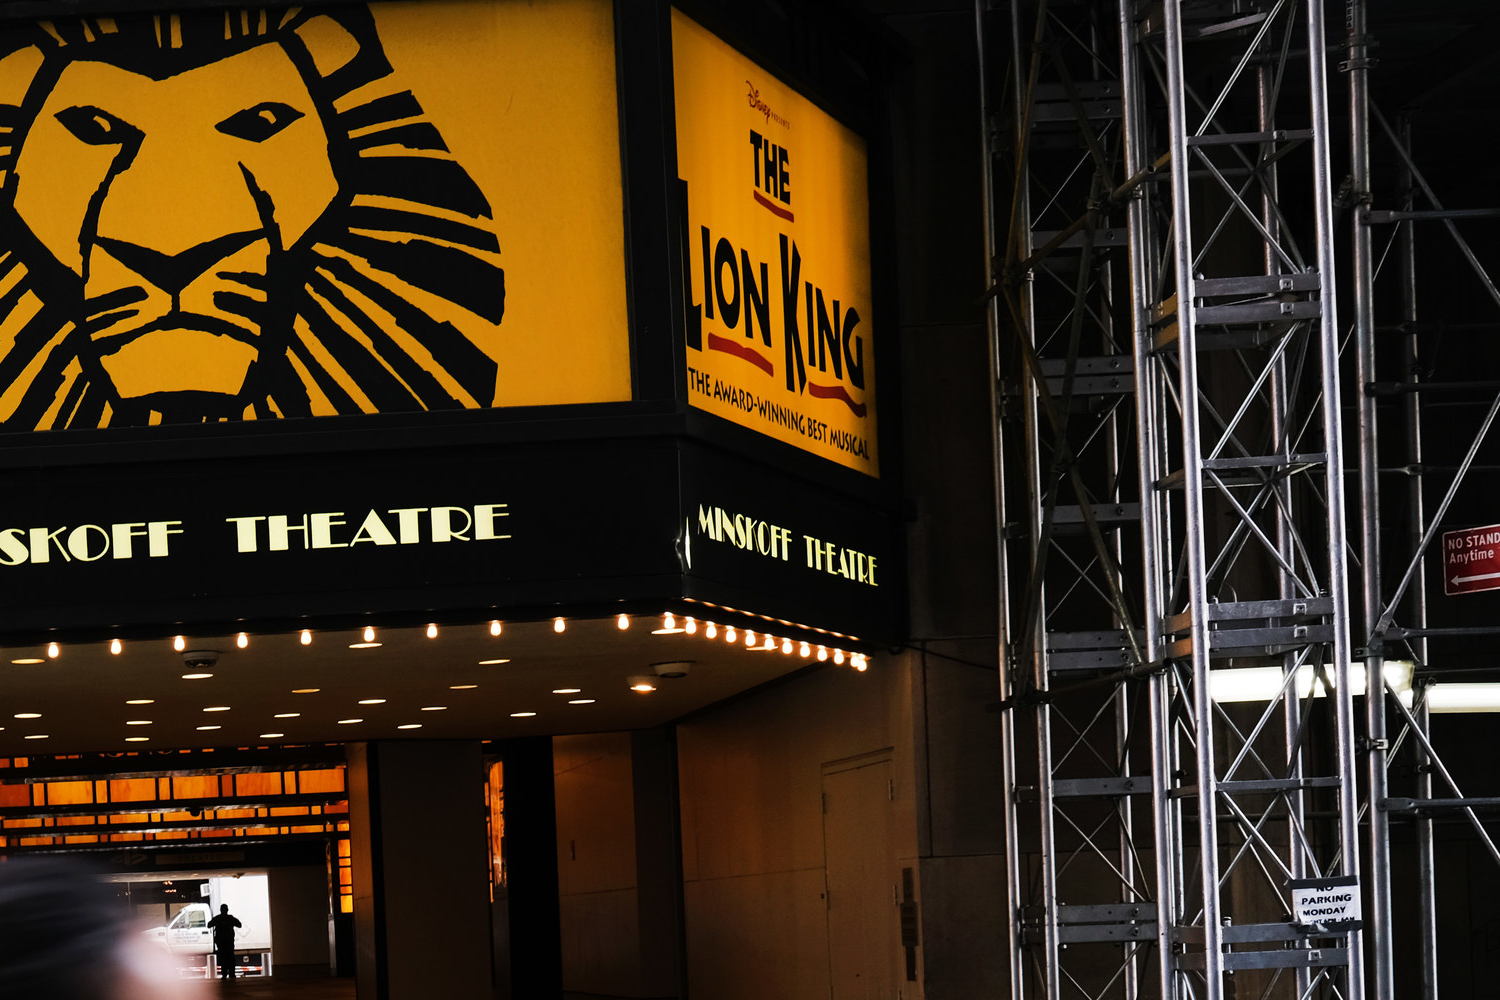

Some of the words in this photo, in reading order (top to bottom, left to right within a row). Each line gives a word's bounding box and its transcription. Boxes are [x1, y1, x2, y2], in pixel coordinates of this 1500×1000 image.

[750, 129, 790, 205] THE
[679, 178, 772, 352] LION
[779, 233, 864, 396] KING
[688, 367, 711, 397] THE
[714, 380, 805, 435] AWARD-WINNING
[808, 417, 827, 443] BEST
[830, 429, 870, 460] MUSICAL
[226, 504, 511, 553] THEATRE
[698, 503, 792, 561] MINSKOFF
[803, 535, 878, 586] THEATRE
[1448, 538, 1463, 550] NO
[1449, 549, 1494, 565] Anytime
[1301, 894, 1351, 905] PARKING
[1303, 907, 1346, 916] MONDAY
